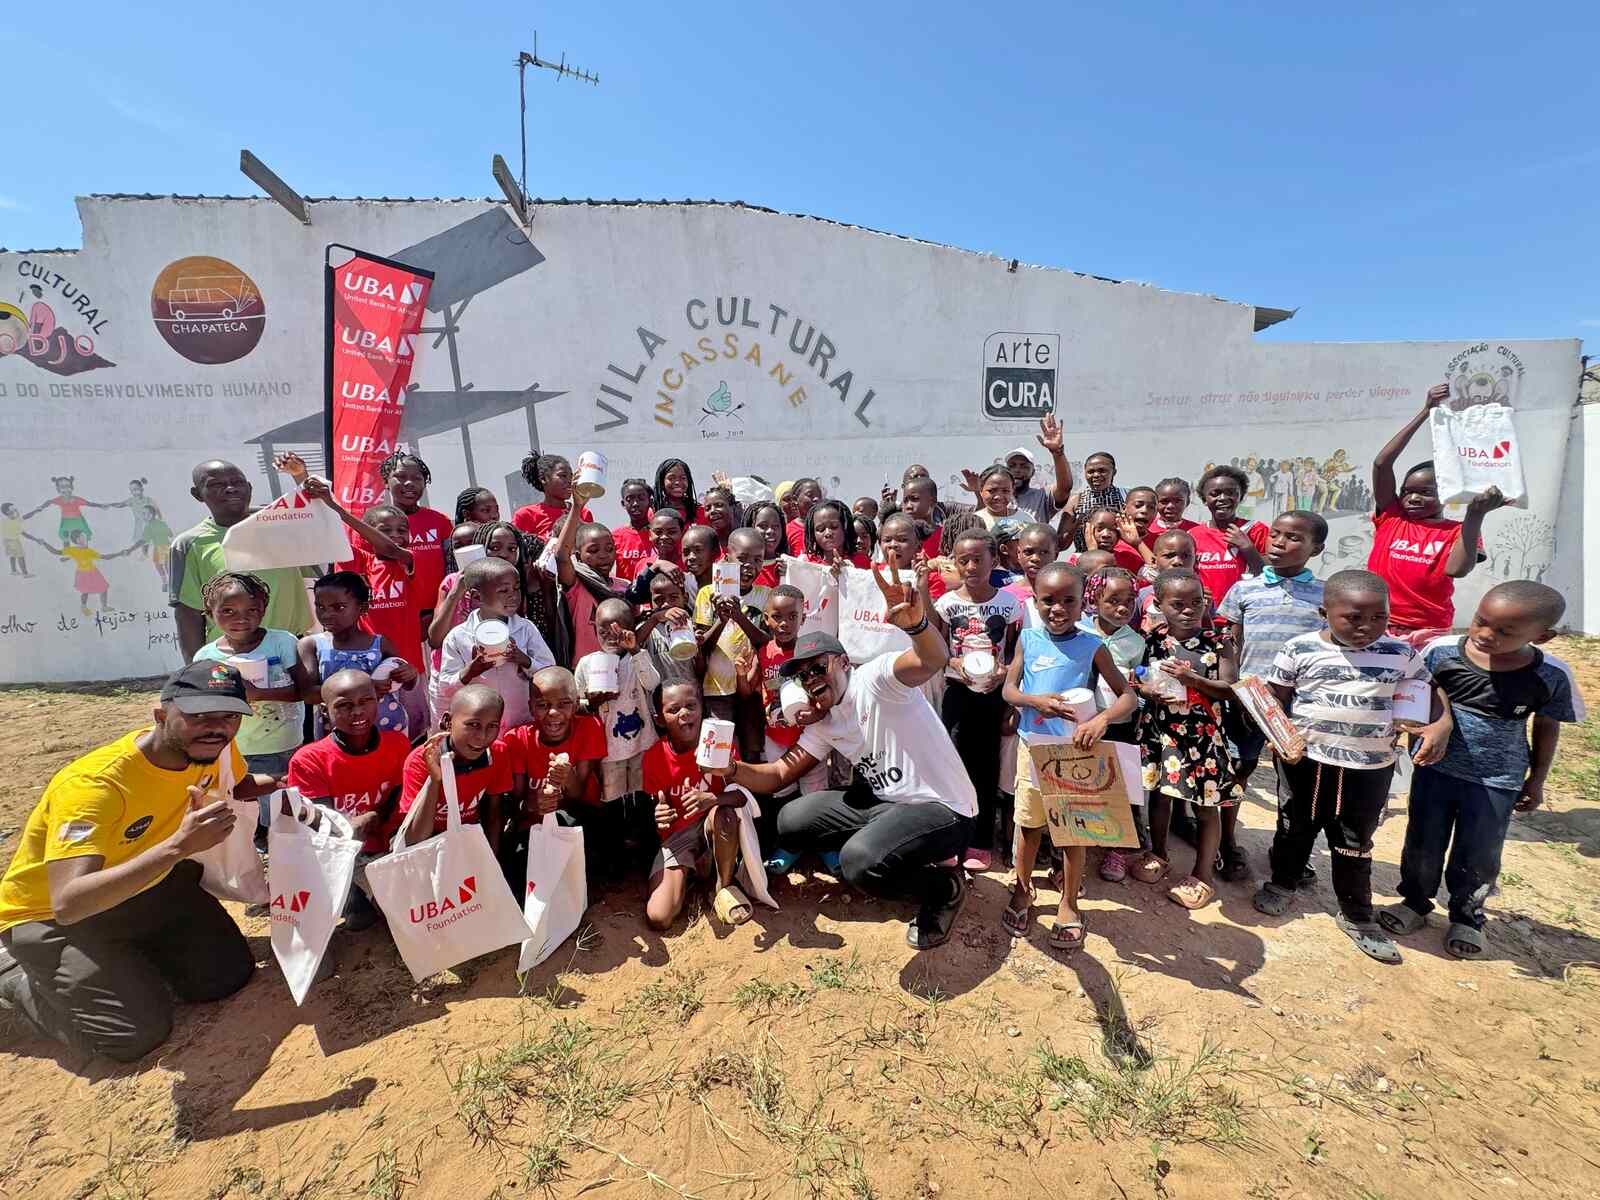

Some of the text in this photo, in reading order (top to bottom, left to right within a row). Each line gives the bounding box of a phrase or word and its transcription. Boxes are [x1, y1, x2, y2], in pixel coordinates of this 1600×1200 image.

[18, 261, 109, 335] CULTURAL
[344, 272, 395, 300] UBA
[171, 321, 248, 334] CHAPATECA
[342, 326, 392, 353] UBA
[995, 337, 1050, 364] Arte
[594, 296, 876, 432] VILA CULTURAL
[16, 383, 39, 398] DO
[223, 381, 292, 397] HUMANO
[342, 381, 391, 405] UBA
[655, 333, 808, 429] INCASSANE
[988, 379, 1054, 409] CURA
[341, 434, 391, 455] UBA
[1457, 446, 1488, 459] UBA
[256, 511, 313, 521] Foundation
[623, 550, 648, 559] UBA
[56, 611, 79, 632] de
[95, 609, 138, 637] feijão
[144, 609, 170, 624] que
[854, 609, 880, 623] UBA
[869, 766, 903, 791] eiro
[334, 791, 370, 812] UBA
[409, 896, 456, 924] UBA
[426, 902, 482, 933] Foundation
